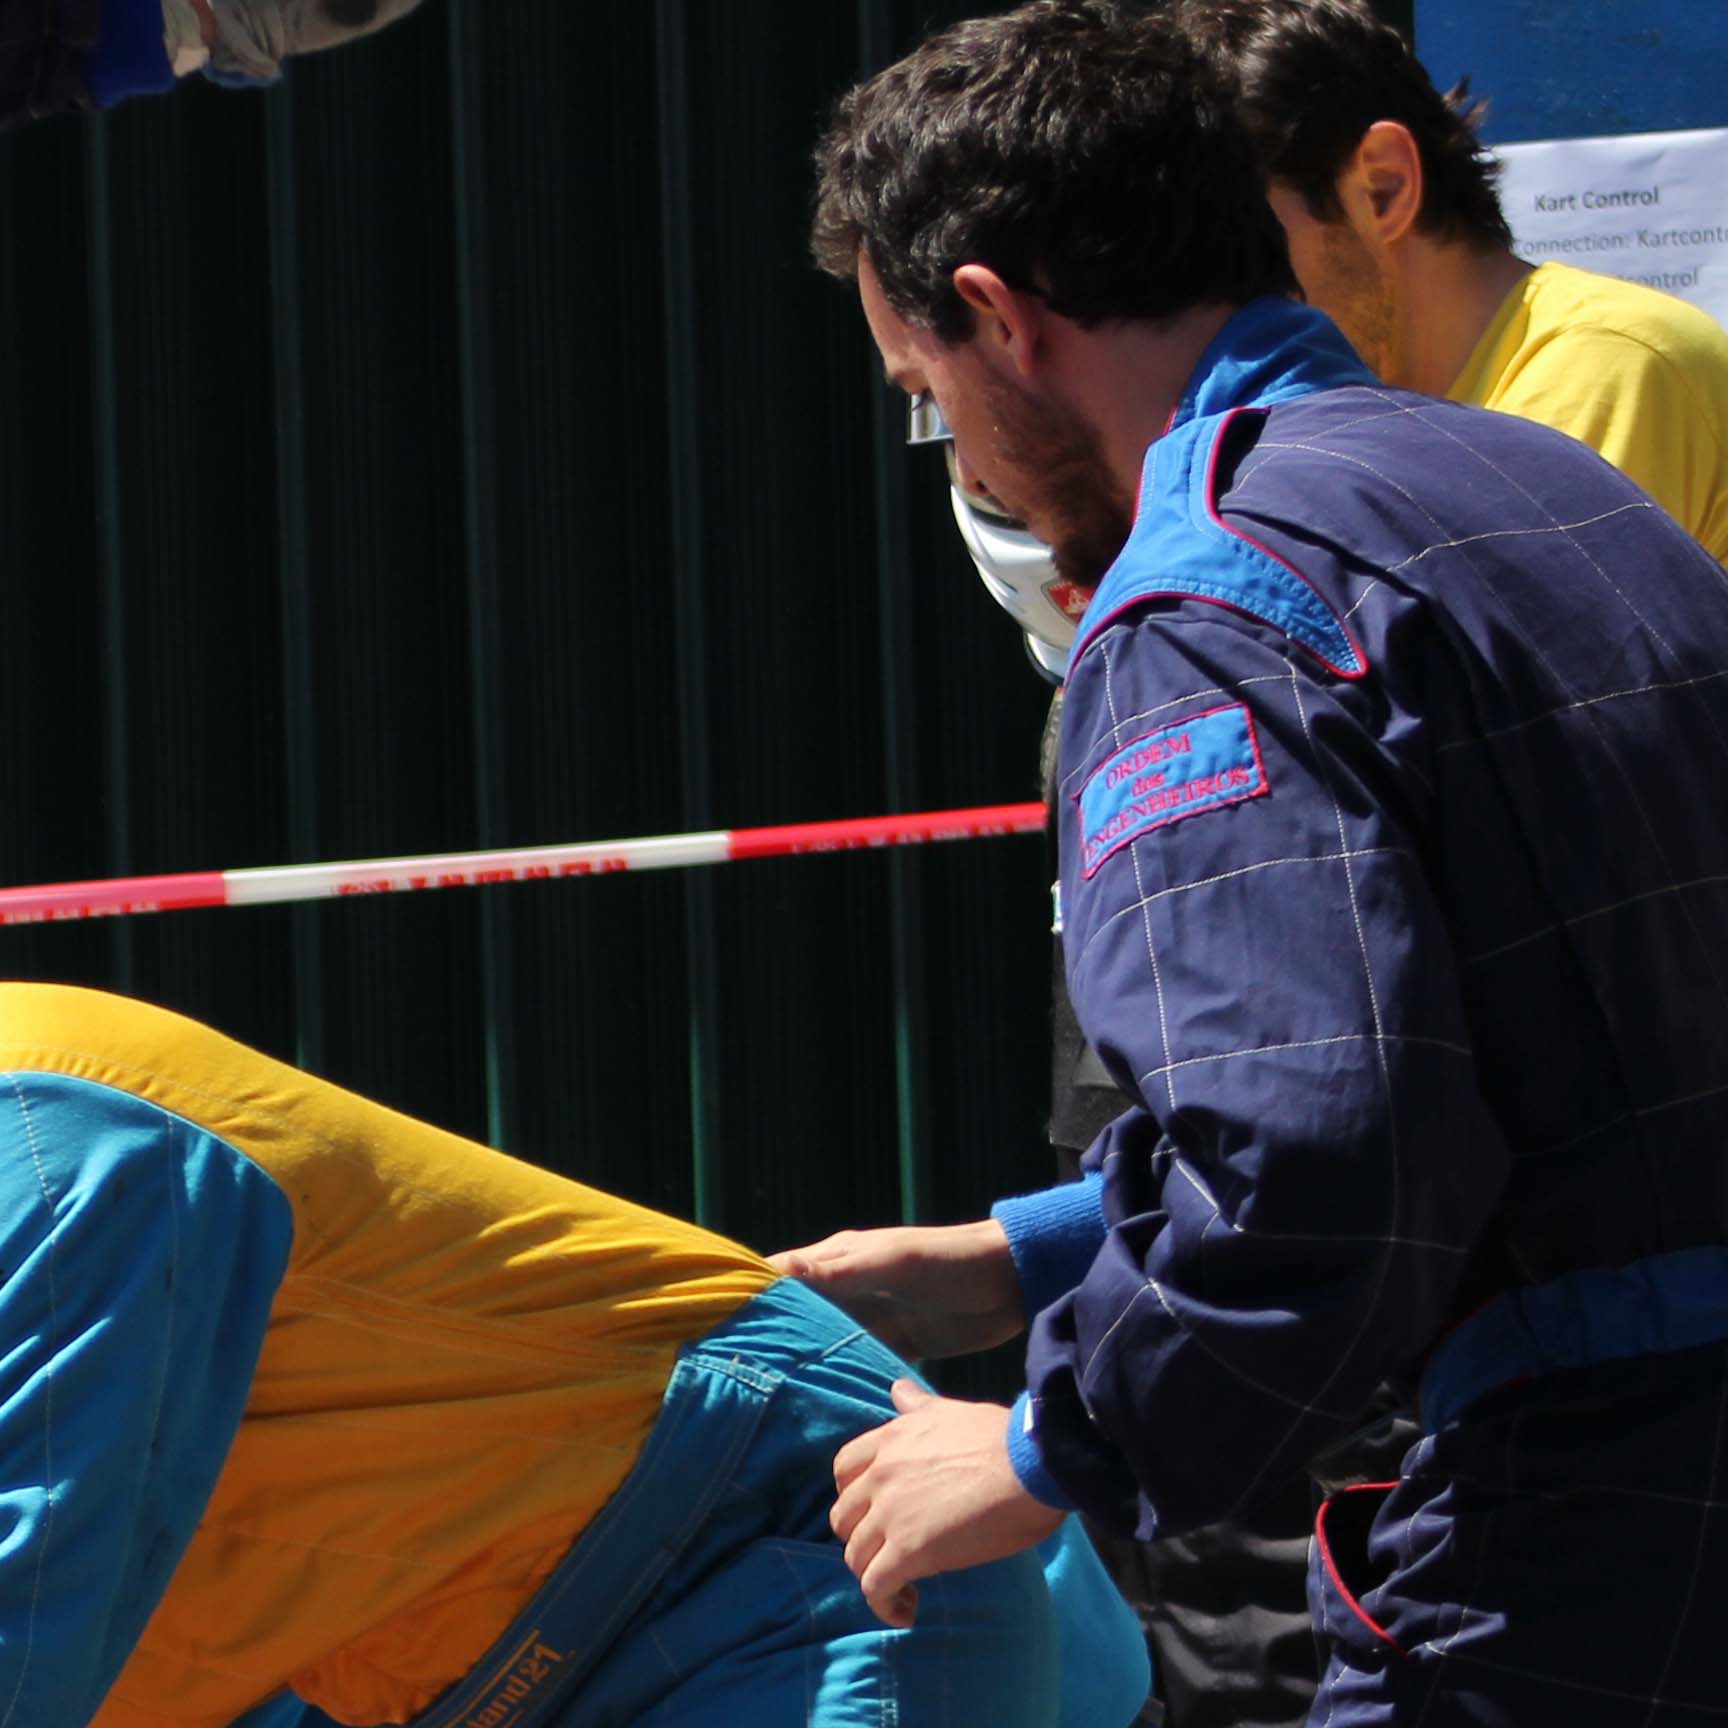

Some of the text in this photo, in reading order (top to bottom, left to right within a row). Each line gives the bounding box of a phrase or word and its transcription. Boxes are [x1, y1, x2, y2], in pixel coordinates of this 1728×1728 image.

[1535, 186, 1660, 212] Kart Control
[1106, 733, 1192, 790] ORDEM
[1133, 772, 1165, 797] dos
[1085, 766, 1250, 868] ENGENHEIROS
